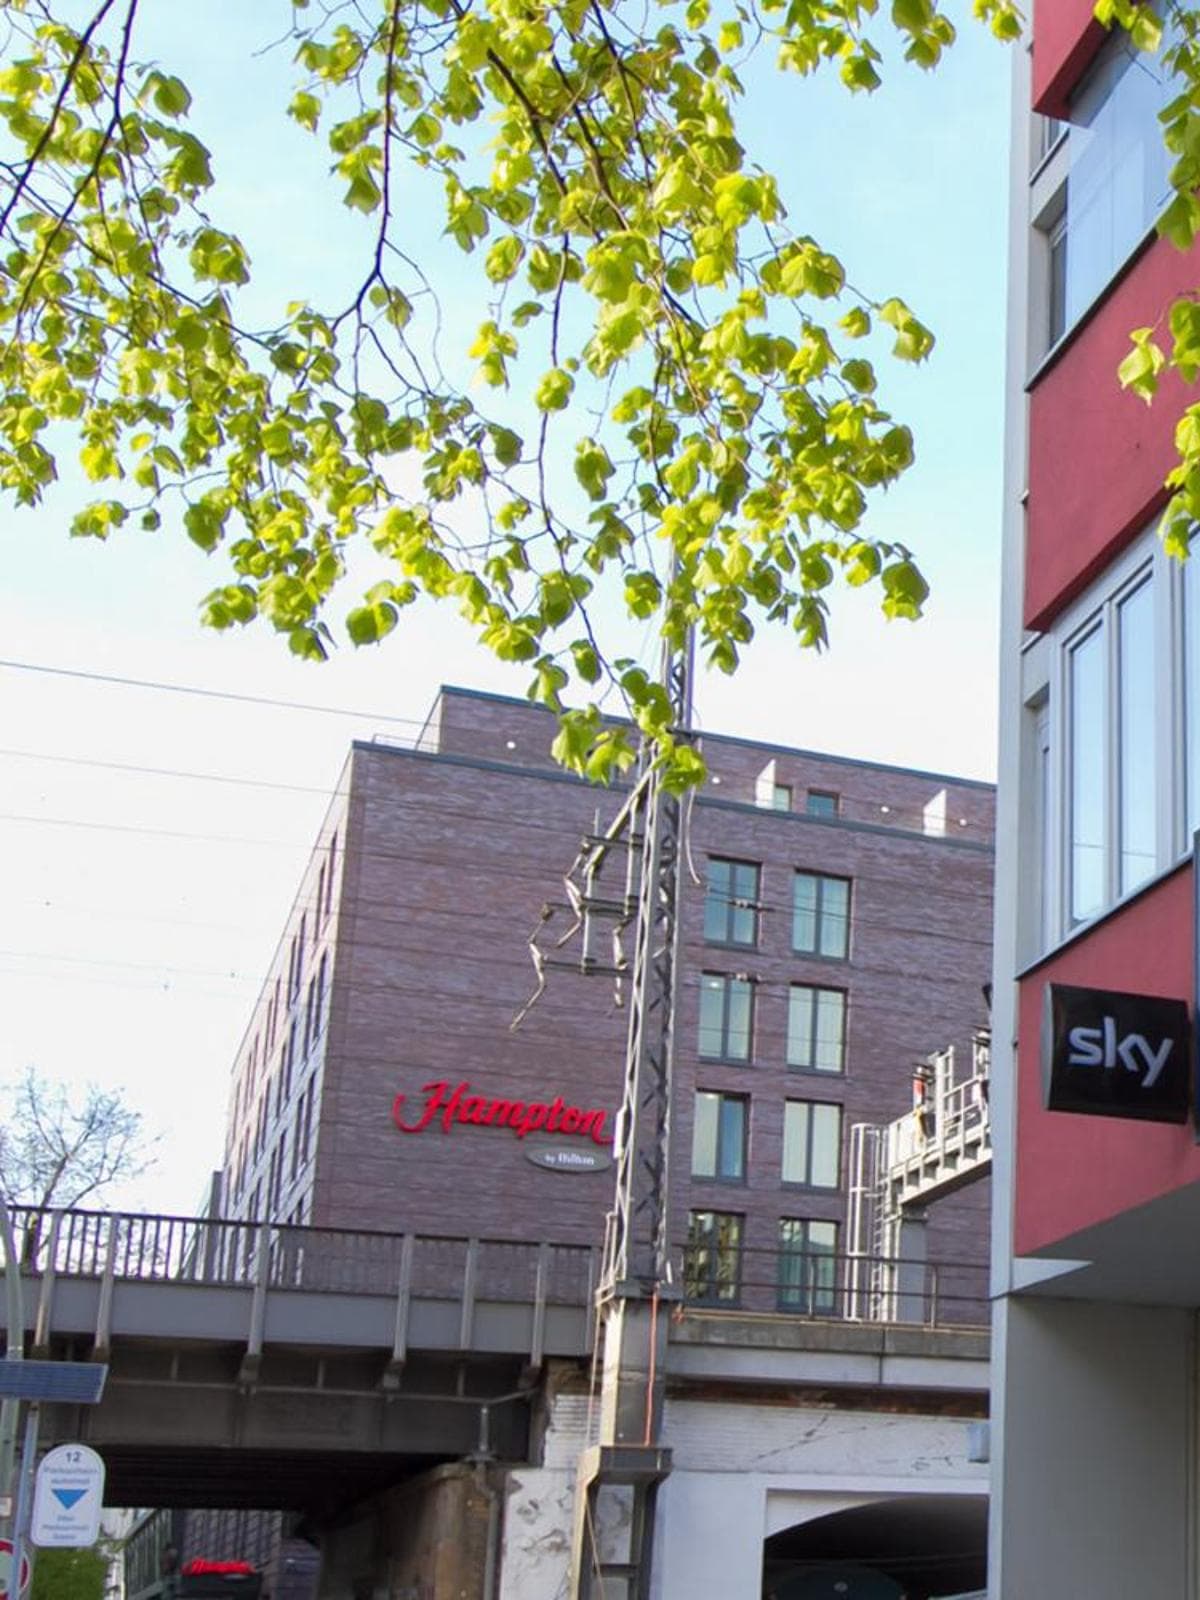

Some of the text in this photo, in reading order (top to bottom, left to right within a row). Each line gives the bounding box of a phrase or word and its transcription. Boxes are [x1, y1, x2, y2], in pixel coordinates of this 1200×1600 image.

[1068, 1016, 1175, 1088] sky
[392, 1079, 615, 1145] Hampton
[66, 1451, 82, 1463] 12
